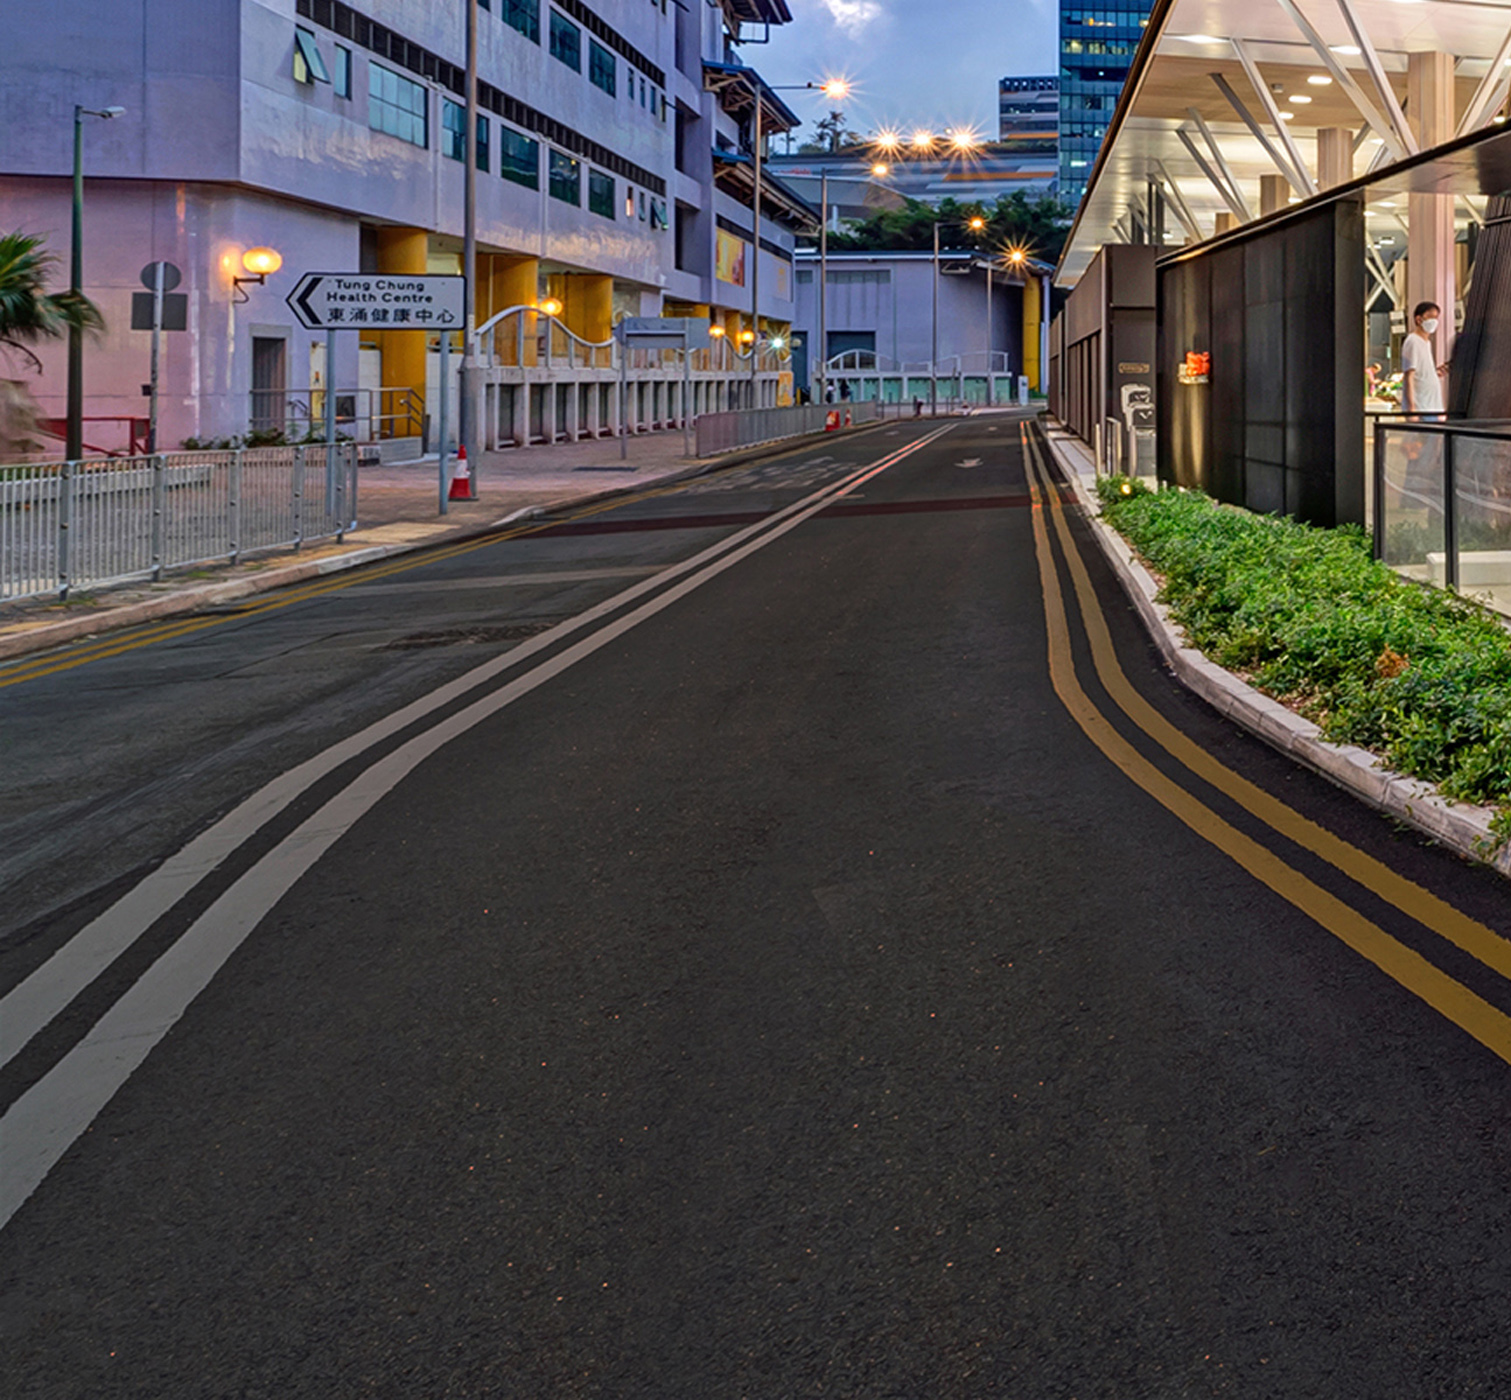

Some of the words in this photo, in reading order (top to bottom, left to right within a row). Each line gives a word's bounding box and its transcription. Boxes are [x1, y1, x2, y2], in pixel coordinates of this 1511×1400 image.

[335, 278, 371, 291] Tung
[375, 279, 424, 292] Chung
[327, 291, 377, 302] Health
[381, 292, 433, 303] Centre
[327, 307, 455, 324] 東涌健康中心
